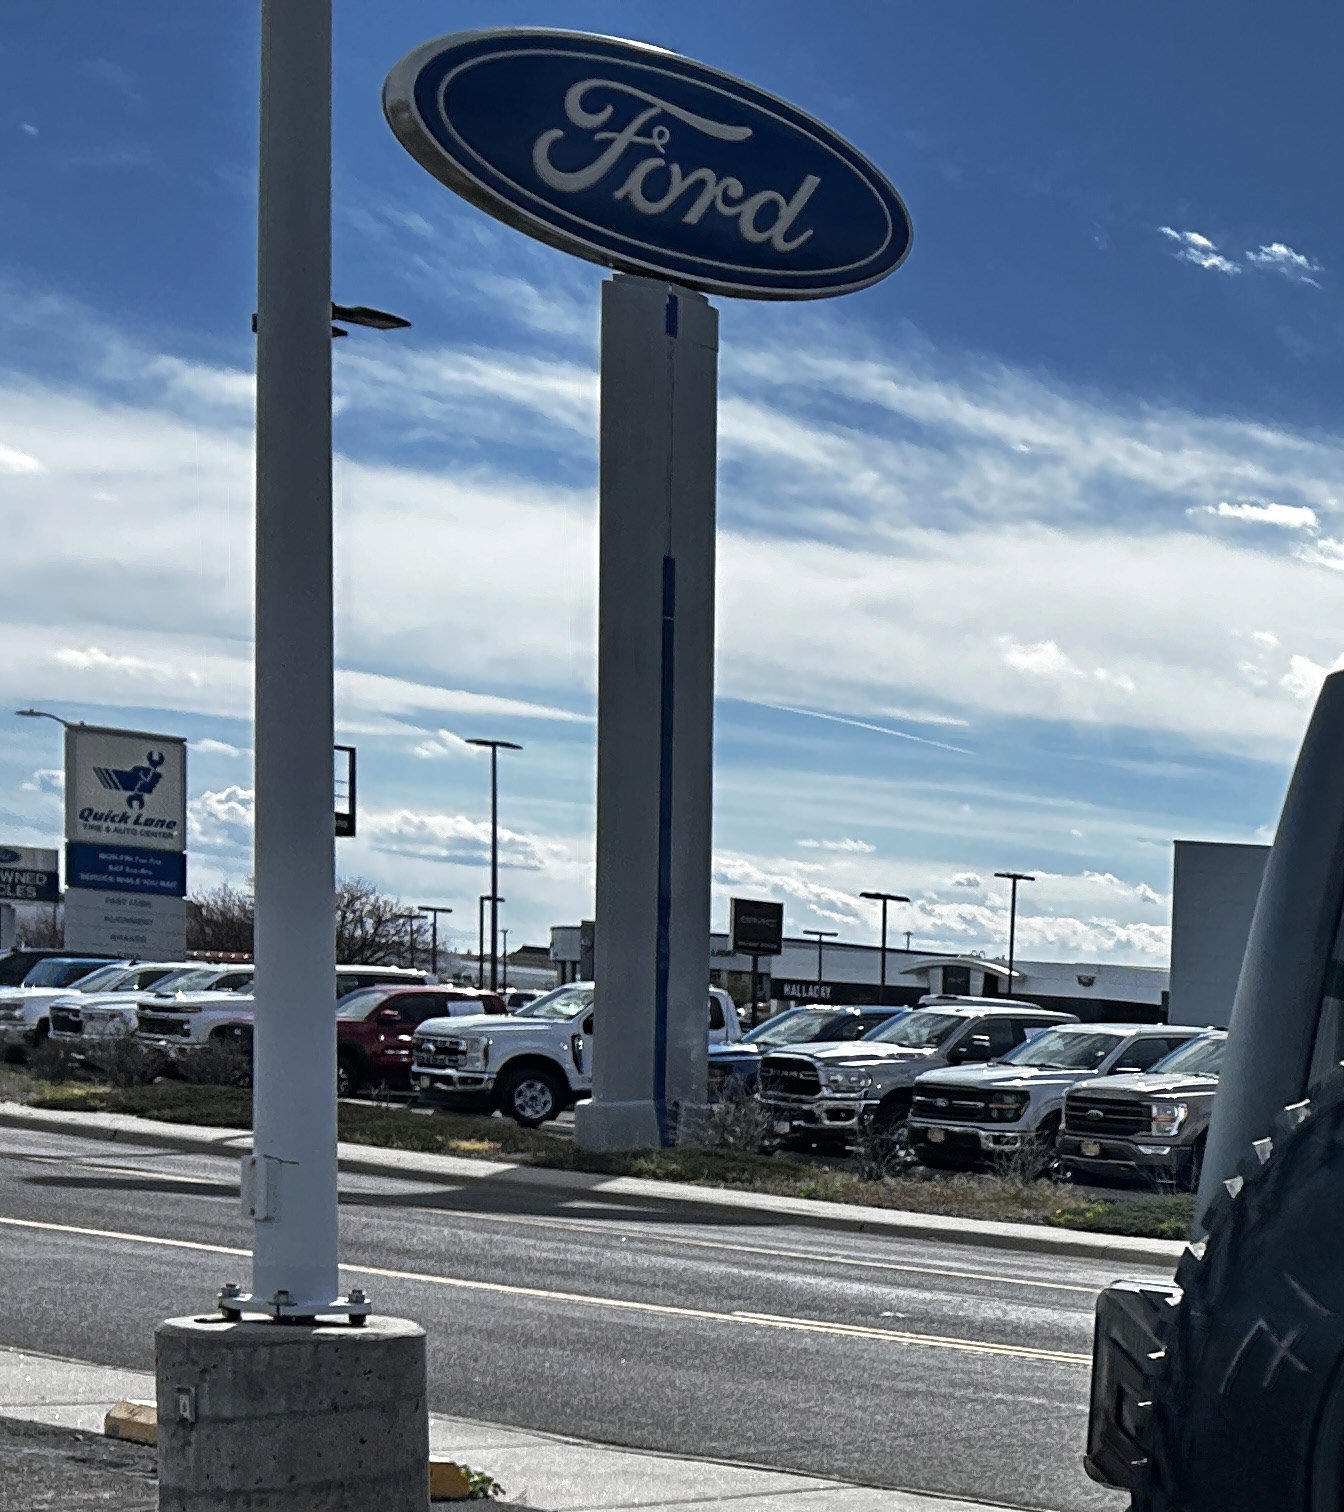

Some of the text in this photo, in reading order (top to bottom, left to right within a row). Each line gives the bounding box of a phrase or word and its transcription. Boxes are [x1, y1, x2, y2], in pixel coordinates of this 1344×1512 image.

[532, 78, 820, 252] Ford
[79, 807, 177, 829] Quick Lane
[113, 826, 138, 836] AUTO
[140, 829, 174, 840] CENTER
